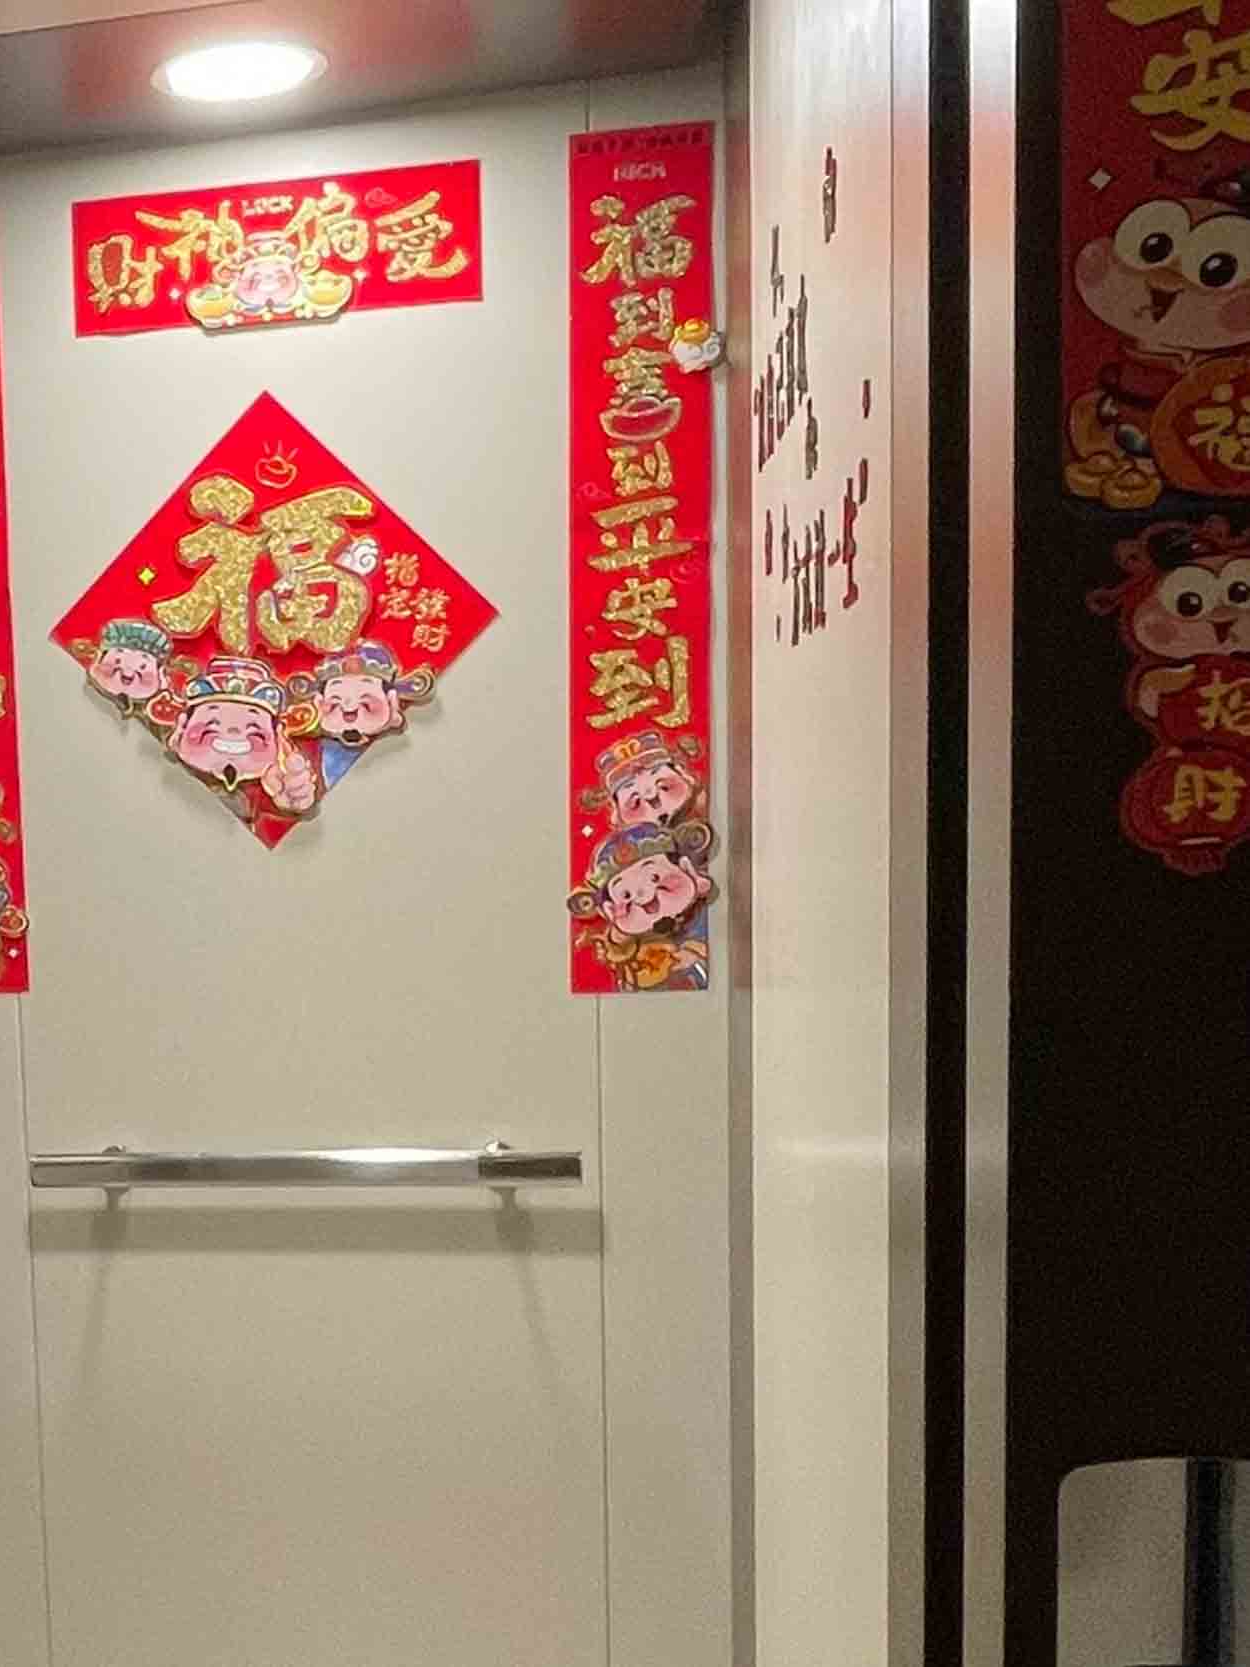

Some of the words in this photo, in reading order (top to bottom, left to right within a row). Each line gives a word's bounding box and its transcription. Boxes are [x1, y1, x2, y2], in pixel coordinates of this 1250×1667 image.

[1105, 0, 1250, 151] 安
[87, 182, 470, 316] 財神偏愛
[240, 195, 295, 216] LUCK
[579, 194, 698, 730] 福到喜到平安到
[150, 471, 374, 658] 福
